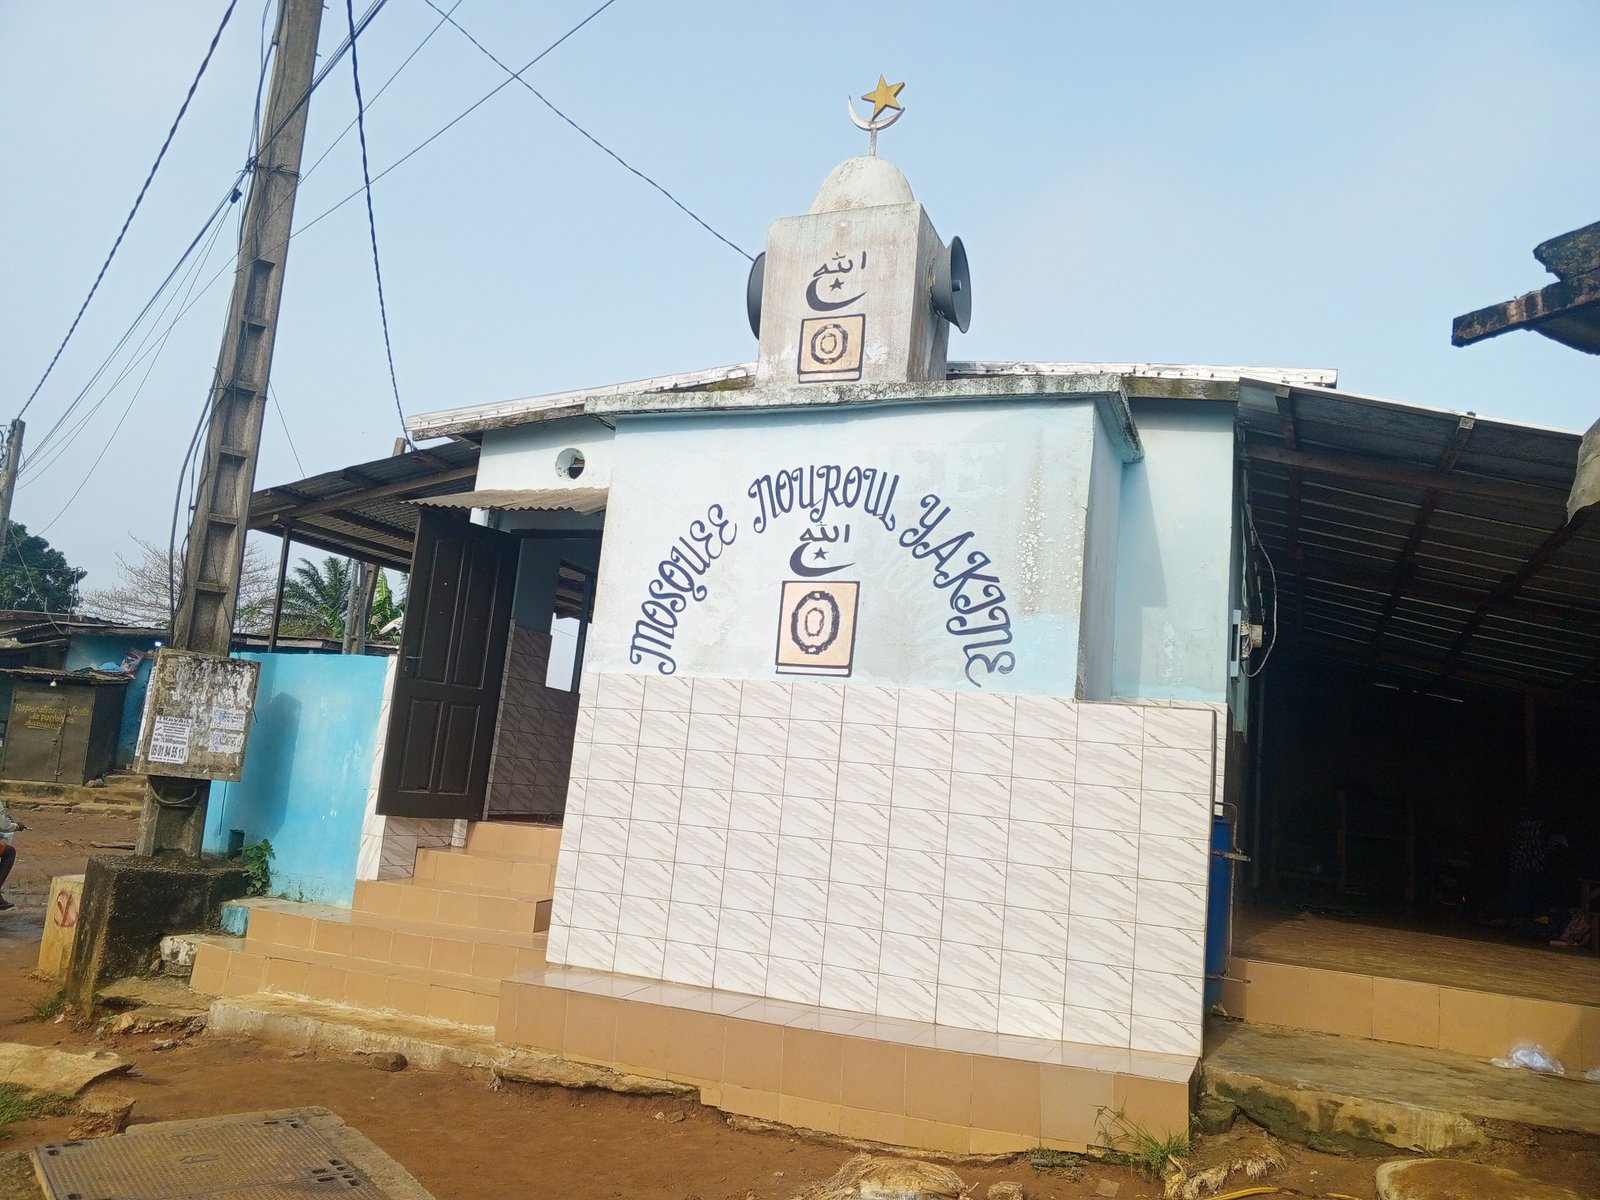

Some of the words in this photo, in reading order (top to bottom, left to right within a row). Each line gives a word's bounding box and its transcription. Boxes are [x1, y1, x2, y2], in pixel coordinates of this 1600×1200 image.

[629, 503, 738, 675] MOSQUEE
[898, 493, 1016, 688] YAKINE
[159, 716, 191, 725] TRAVAIL
